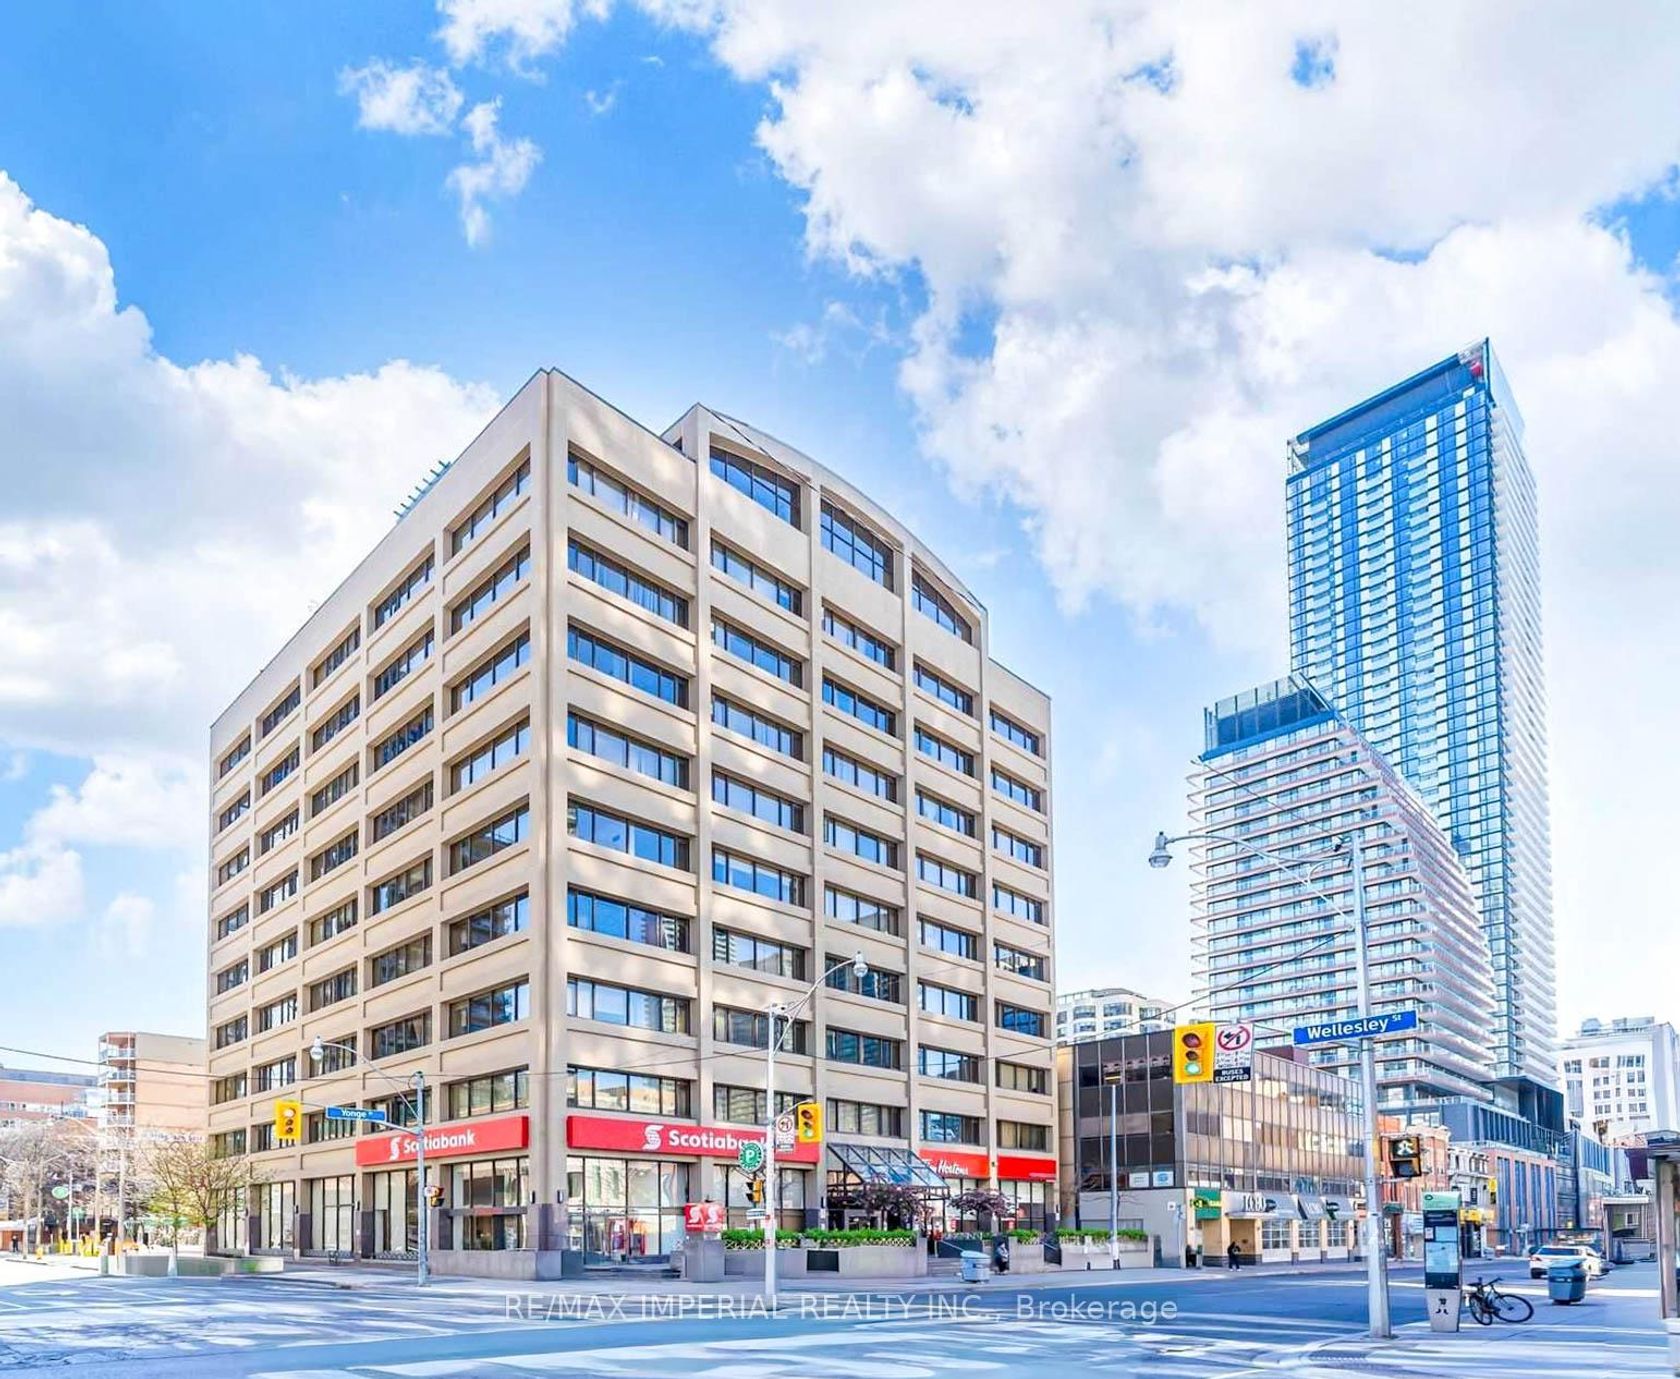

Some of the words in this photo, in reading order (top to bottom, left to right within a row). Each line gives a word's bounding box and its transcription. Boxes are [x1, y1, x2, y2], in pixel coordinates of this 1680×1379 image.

[1307, 1018, 1388, 1040] Wellesley
[1215, 1073, 1249, 1082] EXCEPTED
[1221, 1068, 1244, 1076] BUSES
[341, 1108, 367, 1120] Yonge
[668, 1129, 765, 1150] Scotiaba
[745, 1149, 755, 1163] P
